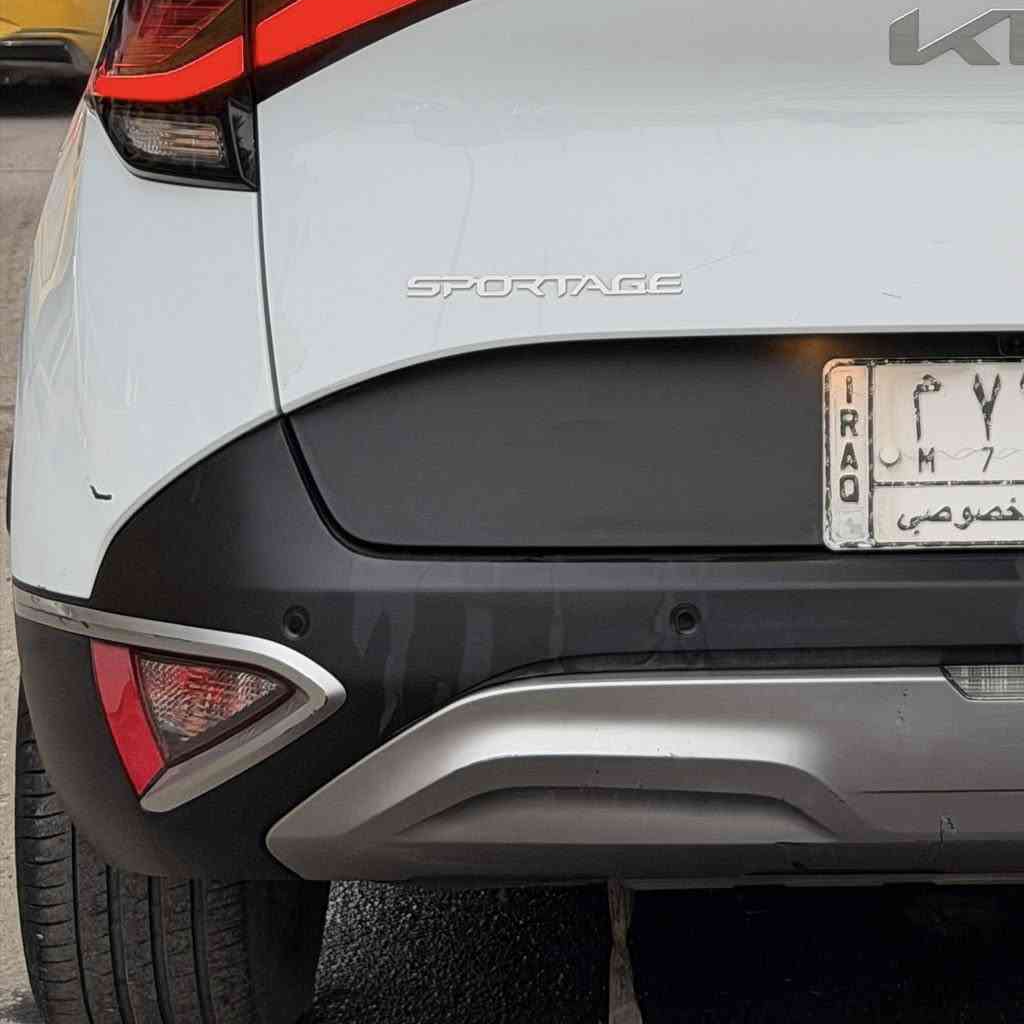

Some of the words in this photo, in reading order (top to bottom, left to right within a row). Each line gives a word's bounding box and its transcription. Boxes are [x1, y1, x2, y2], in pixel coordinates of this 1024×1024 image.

[406, 272, 684, 299] SPORTAGE
[839, 375, 860, 503] IRAQ
[896, 496, 1024, 535] خصوصي
